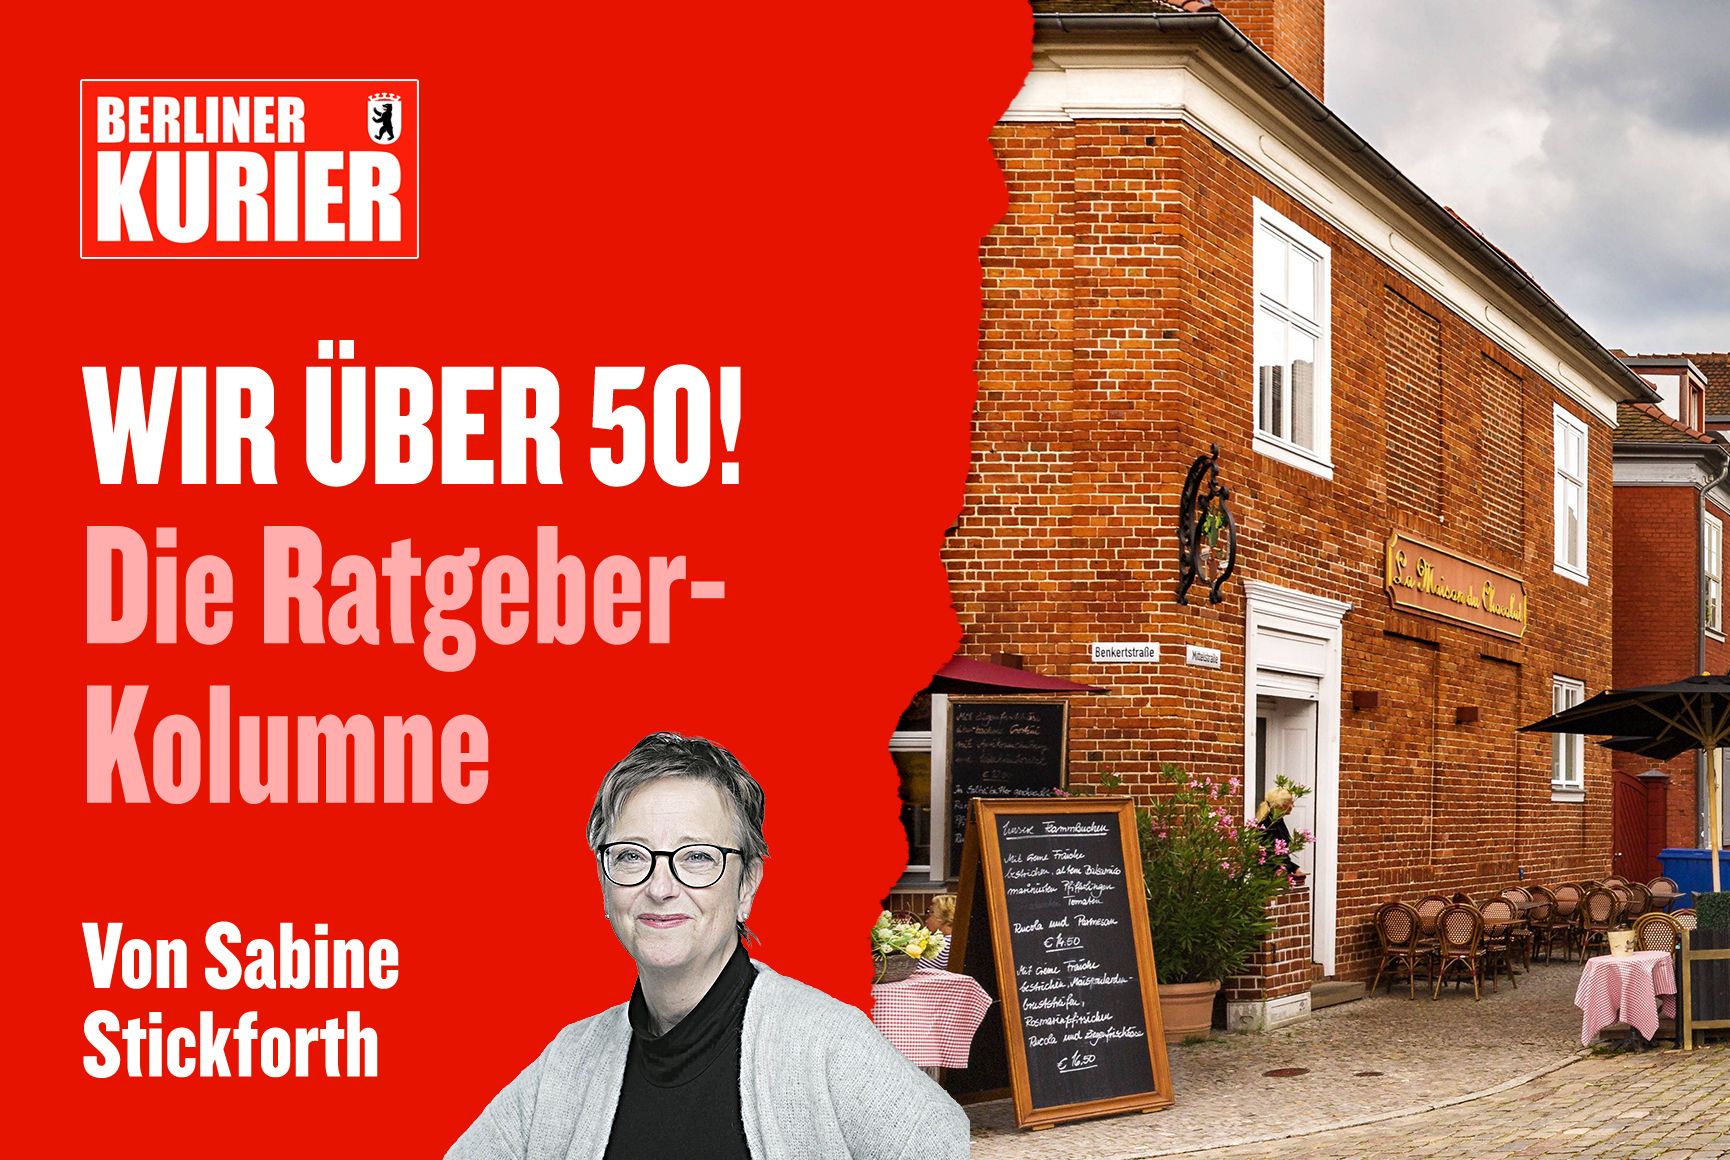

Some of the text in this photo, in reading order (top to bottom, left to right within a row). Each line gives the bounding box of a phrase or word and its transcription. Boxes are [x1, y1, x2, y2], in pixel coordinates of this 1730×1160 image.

[1393, 550, 1415, 589] La
[1416, 556, 1466, 606] Maison
[1466, 585, 1480, 610] du
[1095, 646, 1155, 658] Benkertstraße
[1191, 650, 1219, 665] Mittelstraße
[1004, 853, 1023, 863] Mit
[1055, 865, 1082, 876] altem
[1083, 864, 1121, 876] Balsamico
[1013, 914, 1118, 933] Rucola und Parmesan
[1016, 964, 1031, 976] Mit
[1028, 1033, 1057, 1048] Rucola
[1063, 1031, 1082, 1043] und
